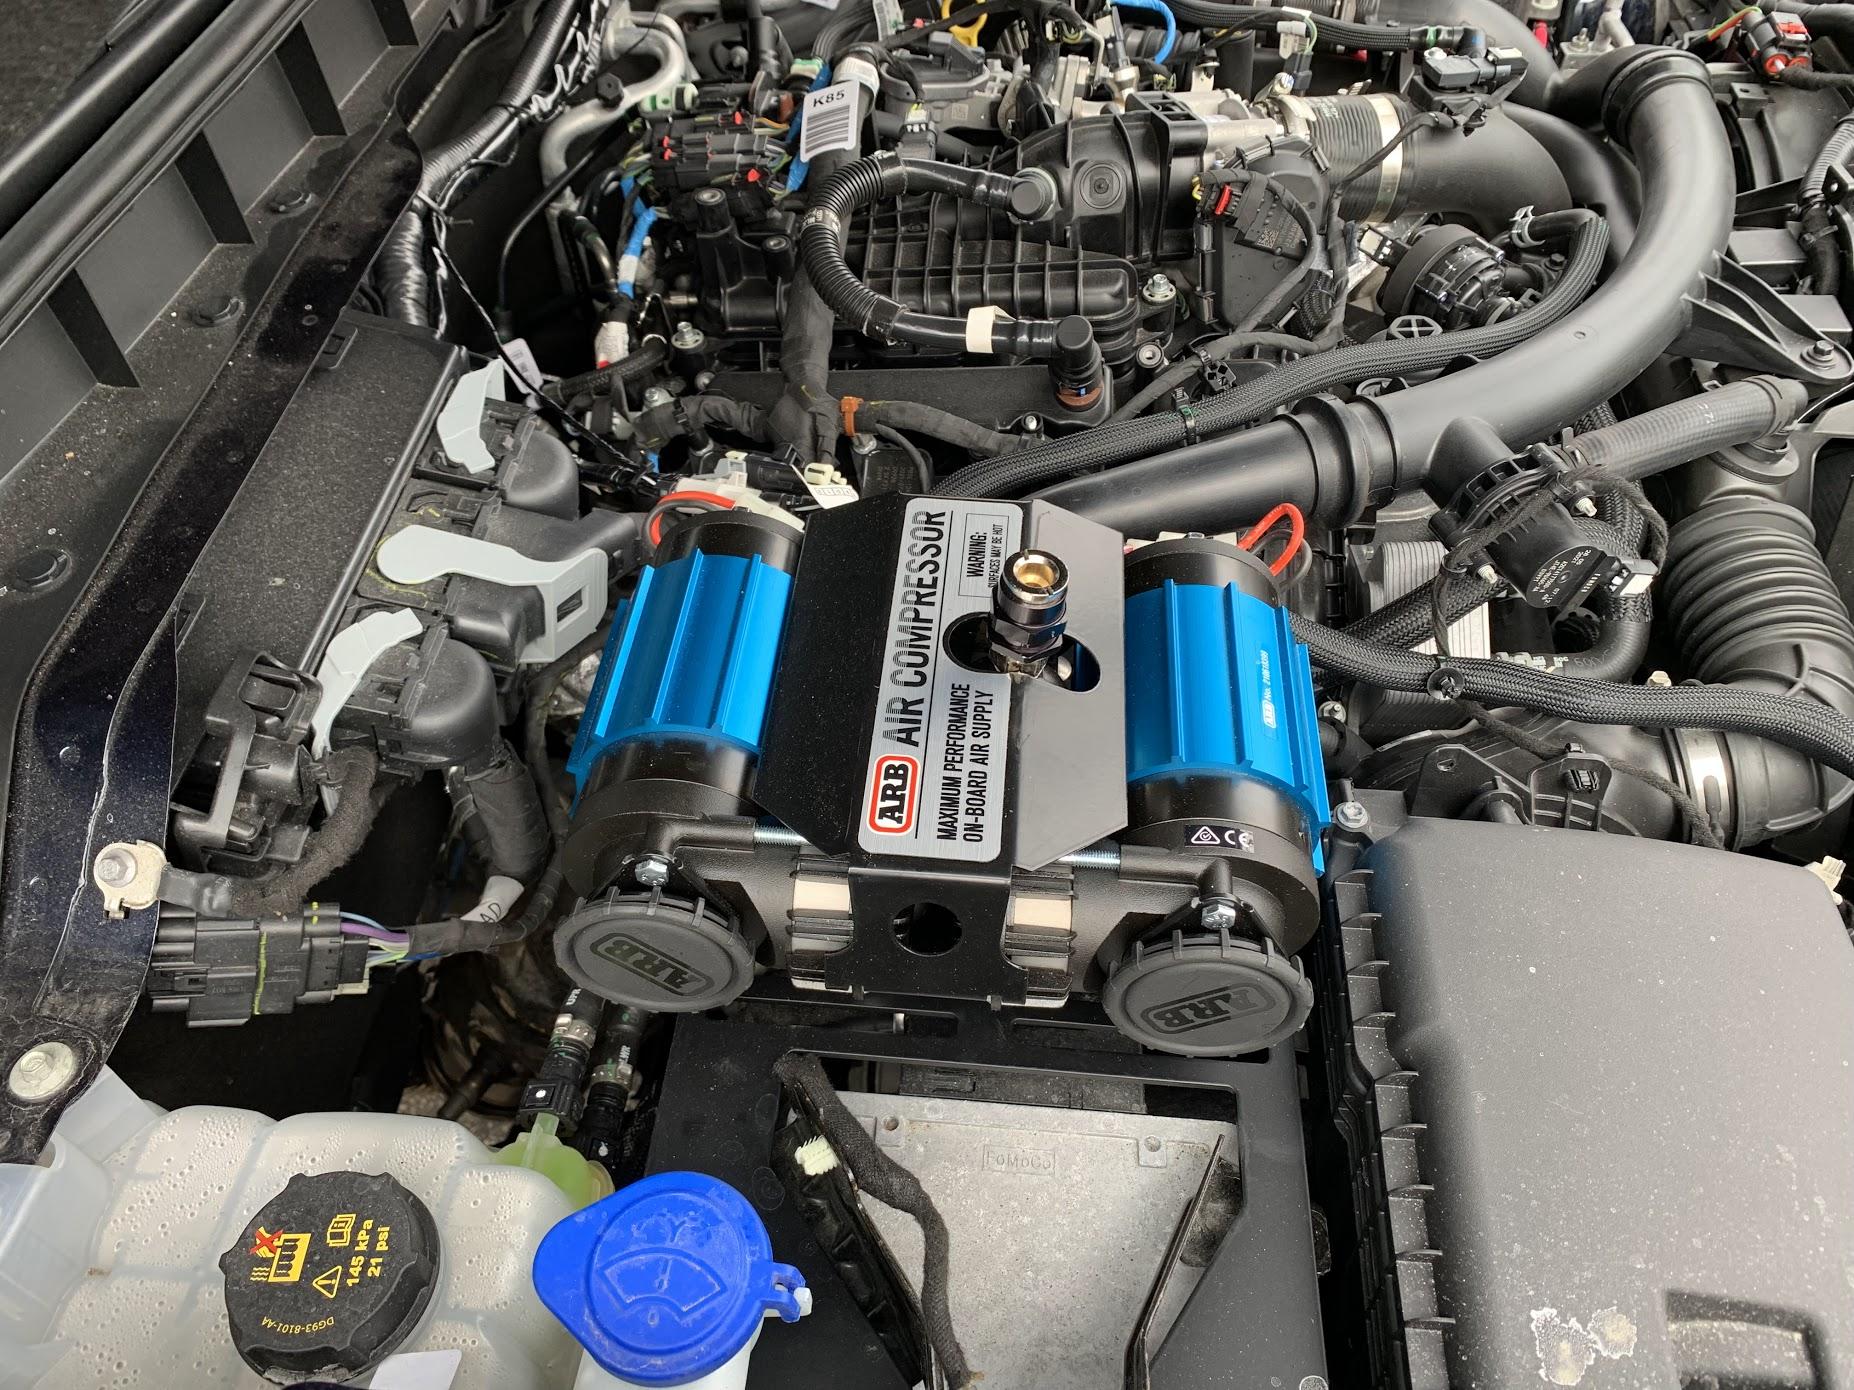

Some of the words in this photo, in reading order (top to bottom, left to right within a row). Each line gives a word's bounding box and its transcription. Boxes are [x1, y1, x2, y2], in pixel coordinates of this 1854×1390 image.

[812, 89, 845, 108] K85
[992, 536, 1002, 545] BE
[993, 523, 1004, 536] HOT
[966, 531, 987, 577] WARNING:
[990, 545, 1002, 558] MAY
[987, 558, 1001, 589] SURFACES
[890, 510, 946, 688] COMPRESSOR
[882, 697, 924, 748] AIR
[944, 683, 971, 772] PERFORMANCE
[972, 690, 994, 739] SUPPLY
[969, 743, 990, 766] AIR
[878, 763, 909, 825] ARB
[936, 775, 962, 841] MAXIMUM
[963, 770, 988, 843] ON-BOARD
[603, 938, 704, 990] ARB
[1152, 988, 1259, 1028] ARB
[986, 1150, 1052, 1170] FoMoCo
[355, 1219, 374, 1251] kPa
[367, 1257, 384, 1277] 21
[376, 1226, 390, 1251] psi
[346, 1255, 365, 1287] 145
[261, 1316, 335, 1335] DG93-8101-AA
